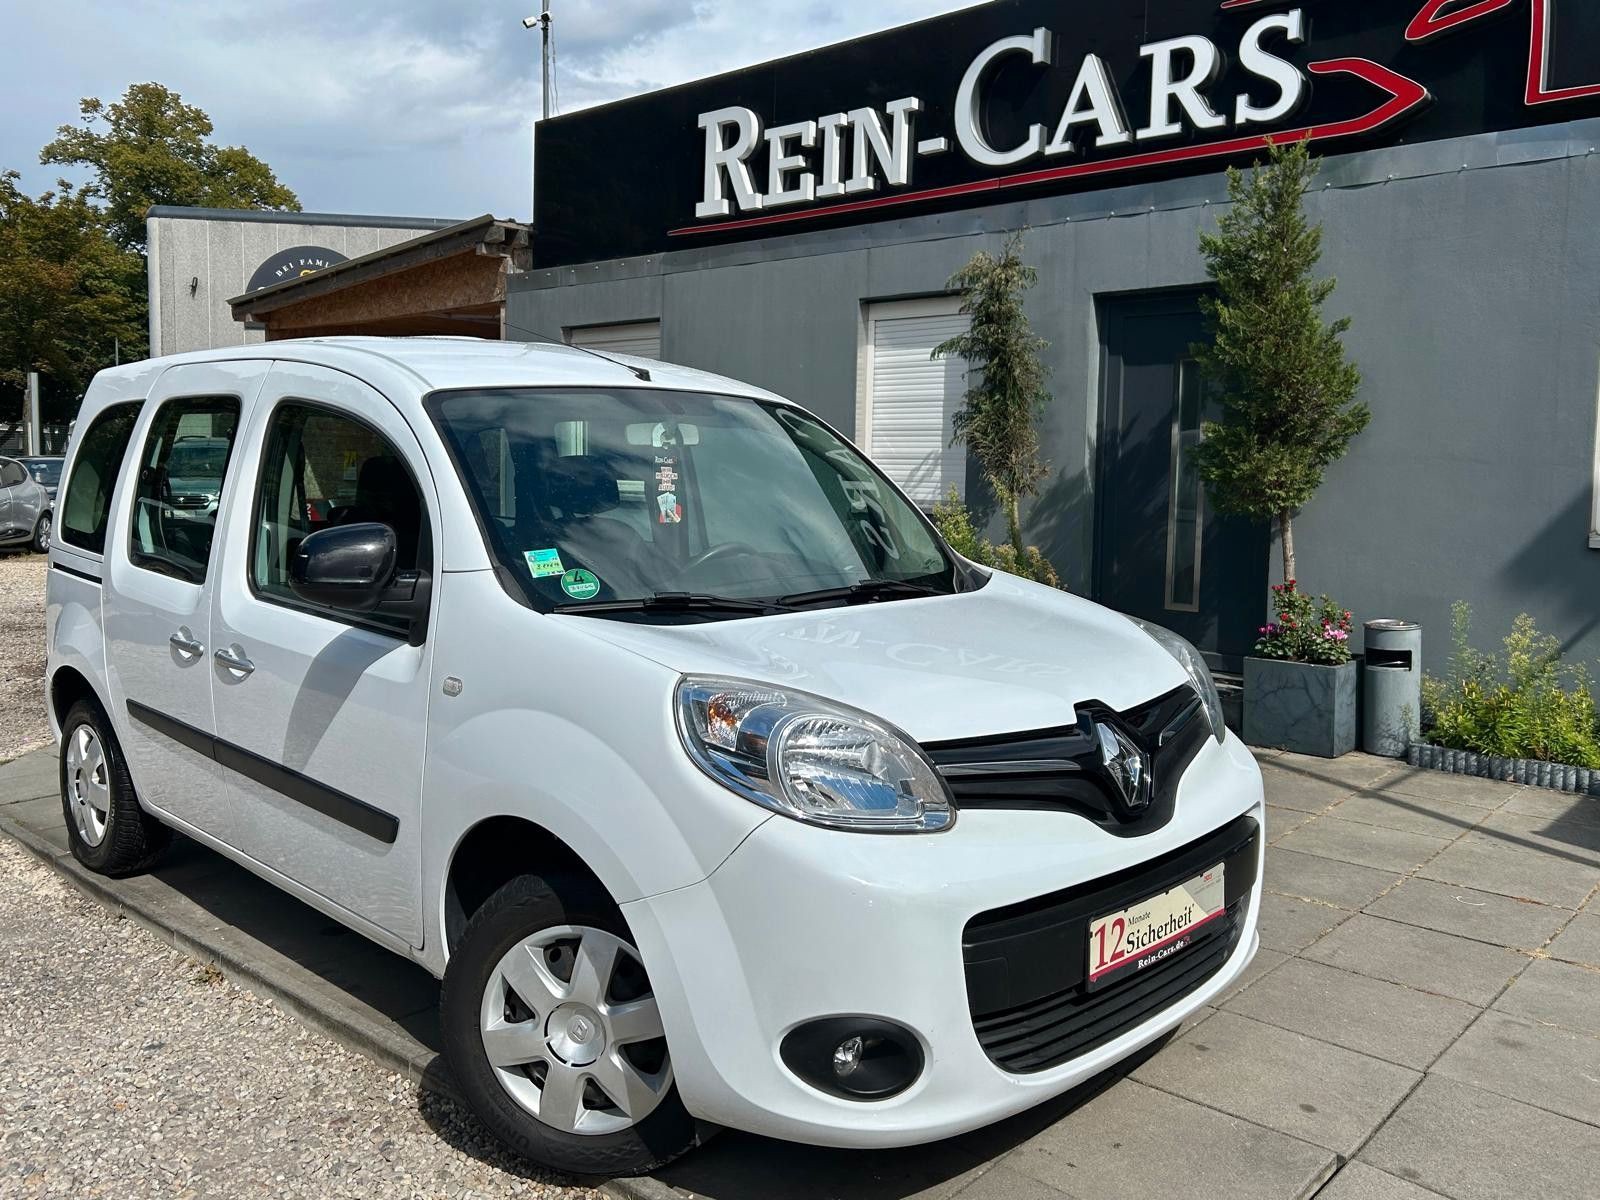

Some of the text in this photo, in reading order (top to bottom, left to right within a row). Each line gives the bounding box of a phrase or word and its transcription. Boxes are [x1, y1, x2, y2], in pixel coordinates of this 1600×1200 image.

[275, 262, 294, 277] BEI
[299, 258, 331, 269] FAMI
[1095, 911, 1151, 970] 12 Monate
[1126, 903, 1193, 954] Sicherheit
[1137, 940, 1184, 969] Rein-Cars.de
